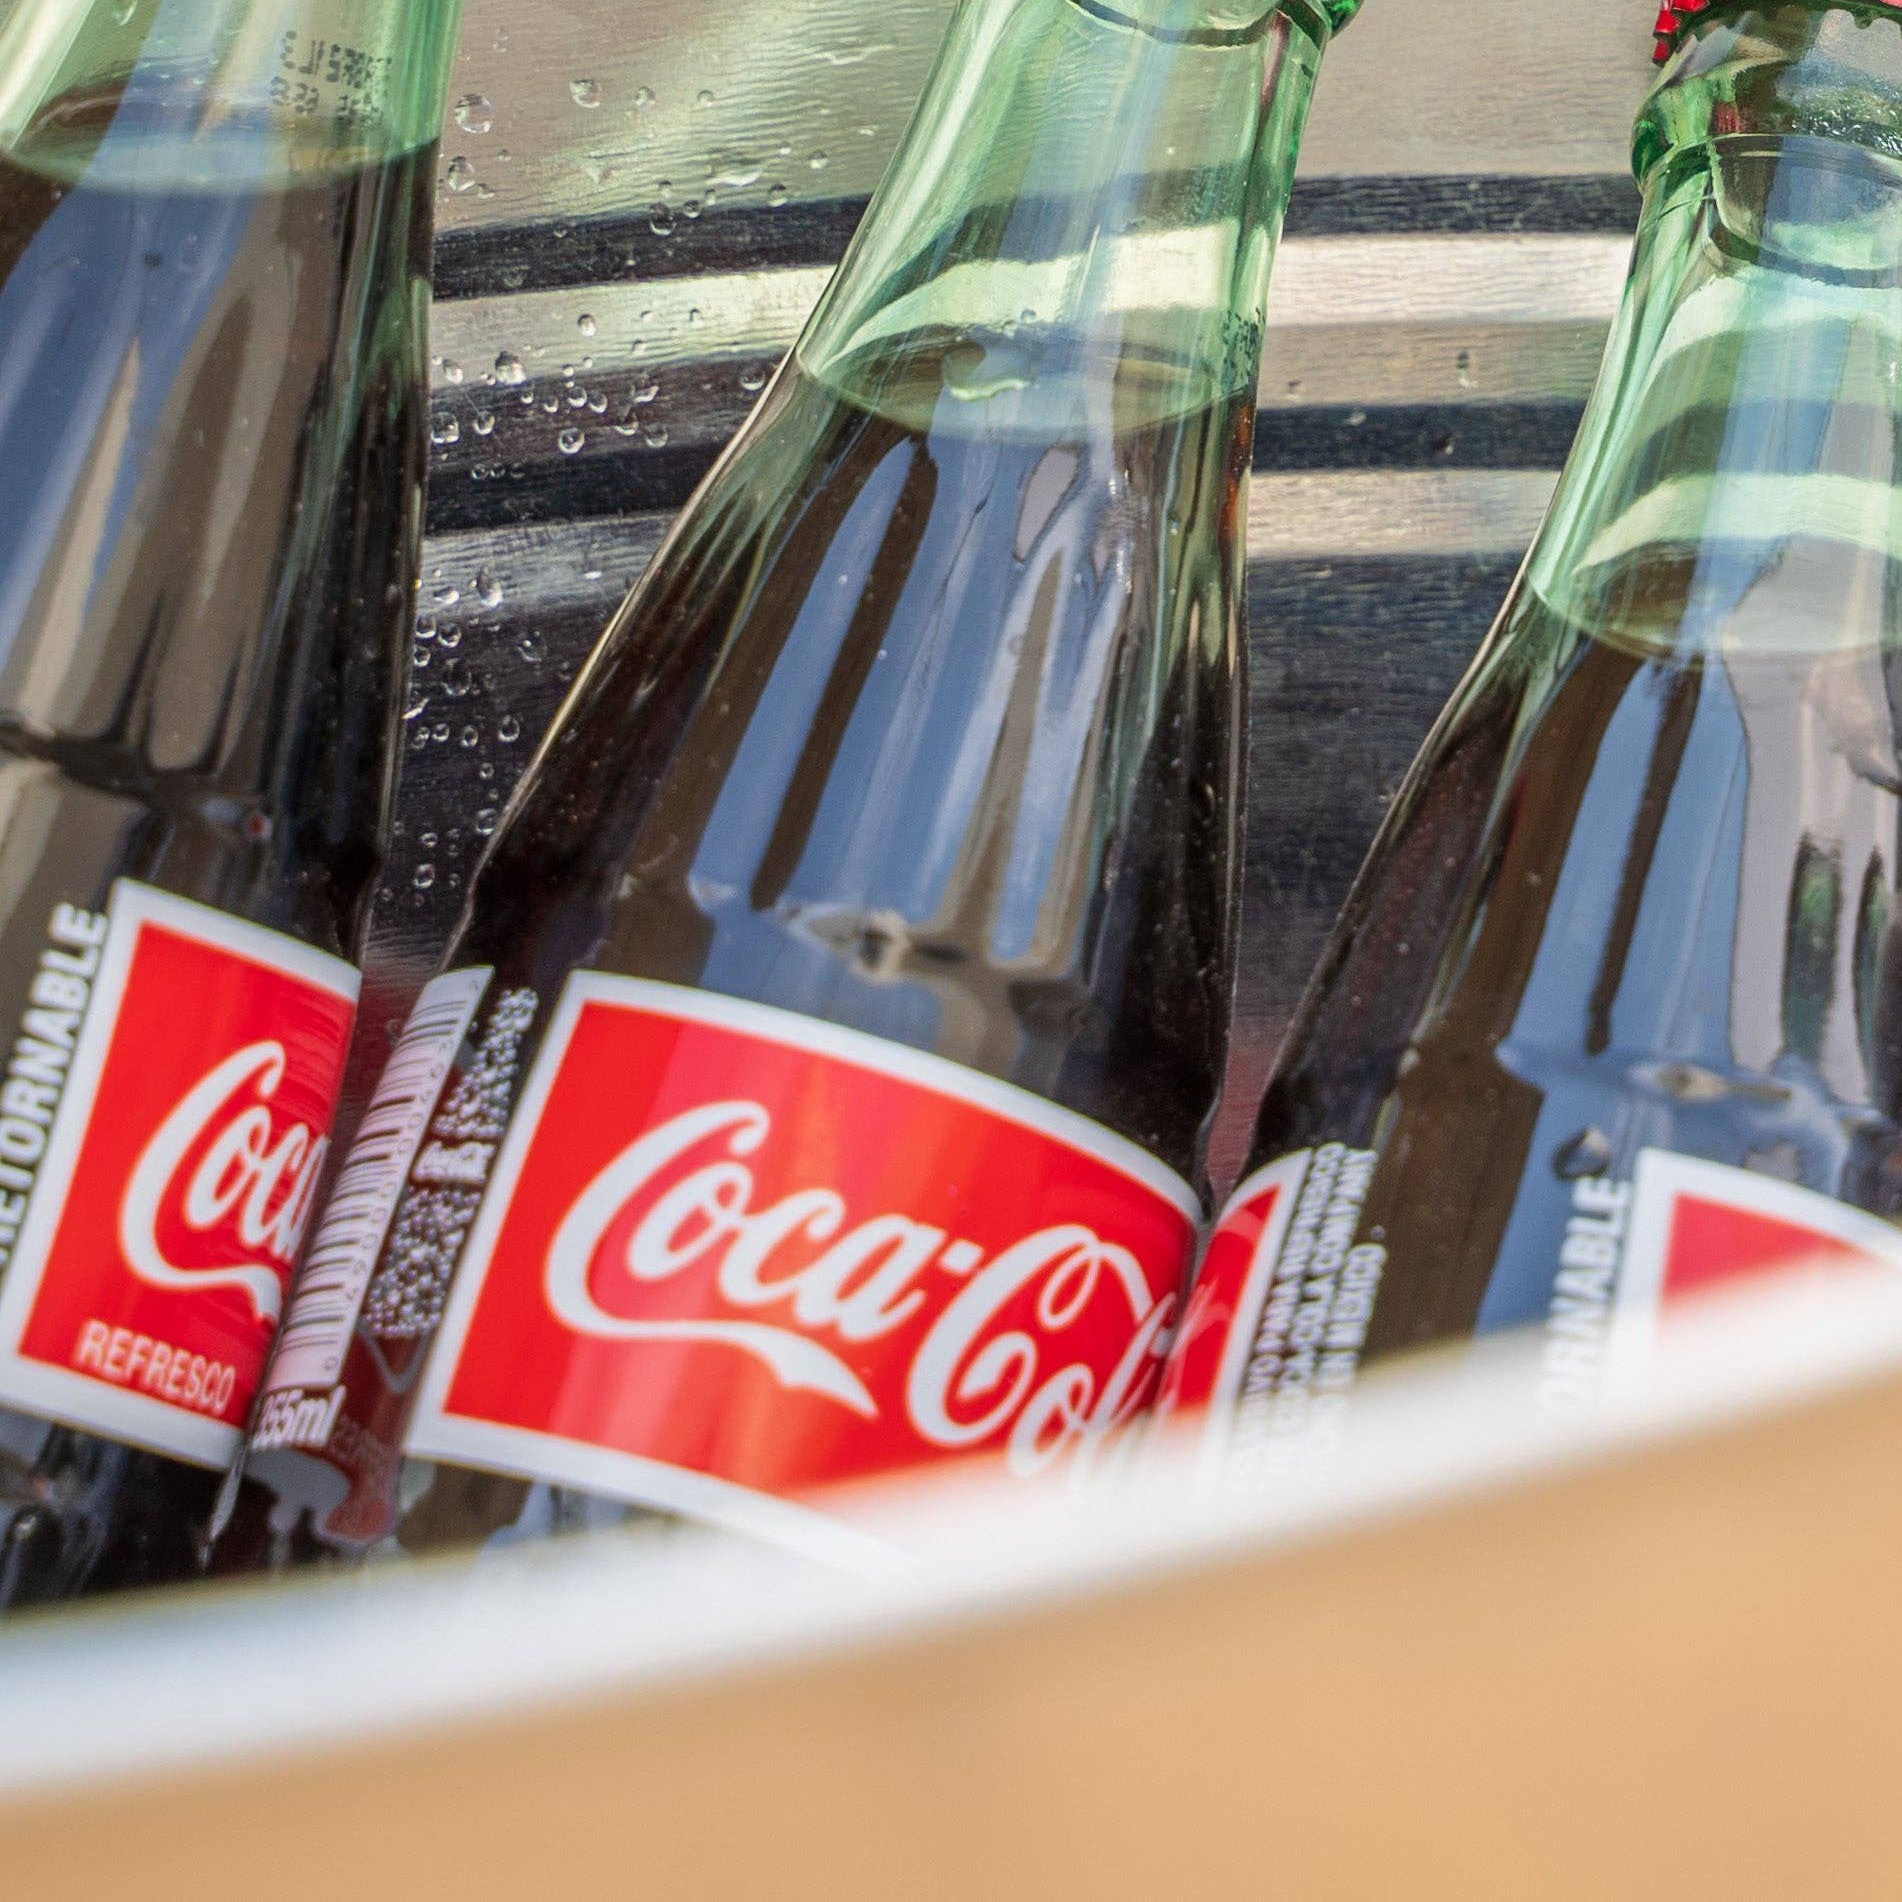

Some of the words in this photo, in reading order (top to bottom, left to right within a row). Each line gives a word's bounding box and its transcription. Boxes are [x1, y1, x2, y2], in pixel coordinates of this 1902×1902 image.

[0, 901, 105, 1268] ETORNABLE
[76, 1319, 236, 1413] REFRESCO
[543, 1102, 1178, 1478] Coca-Col
